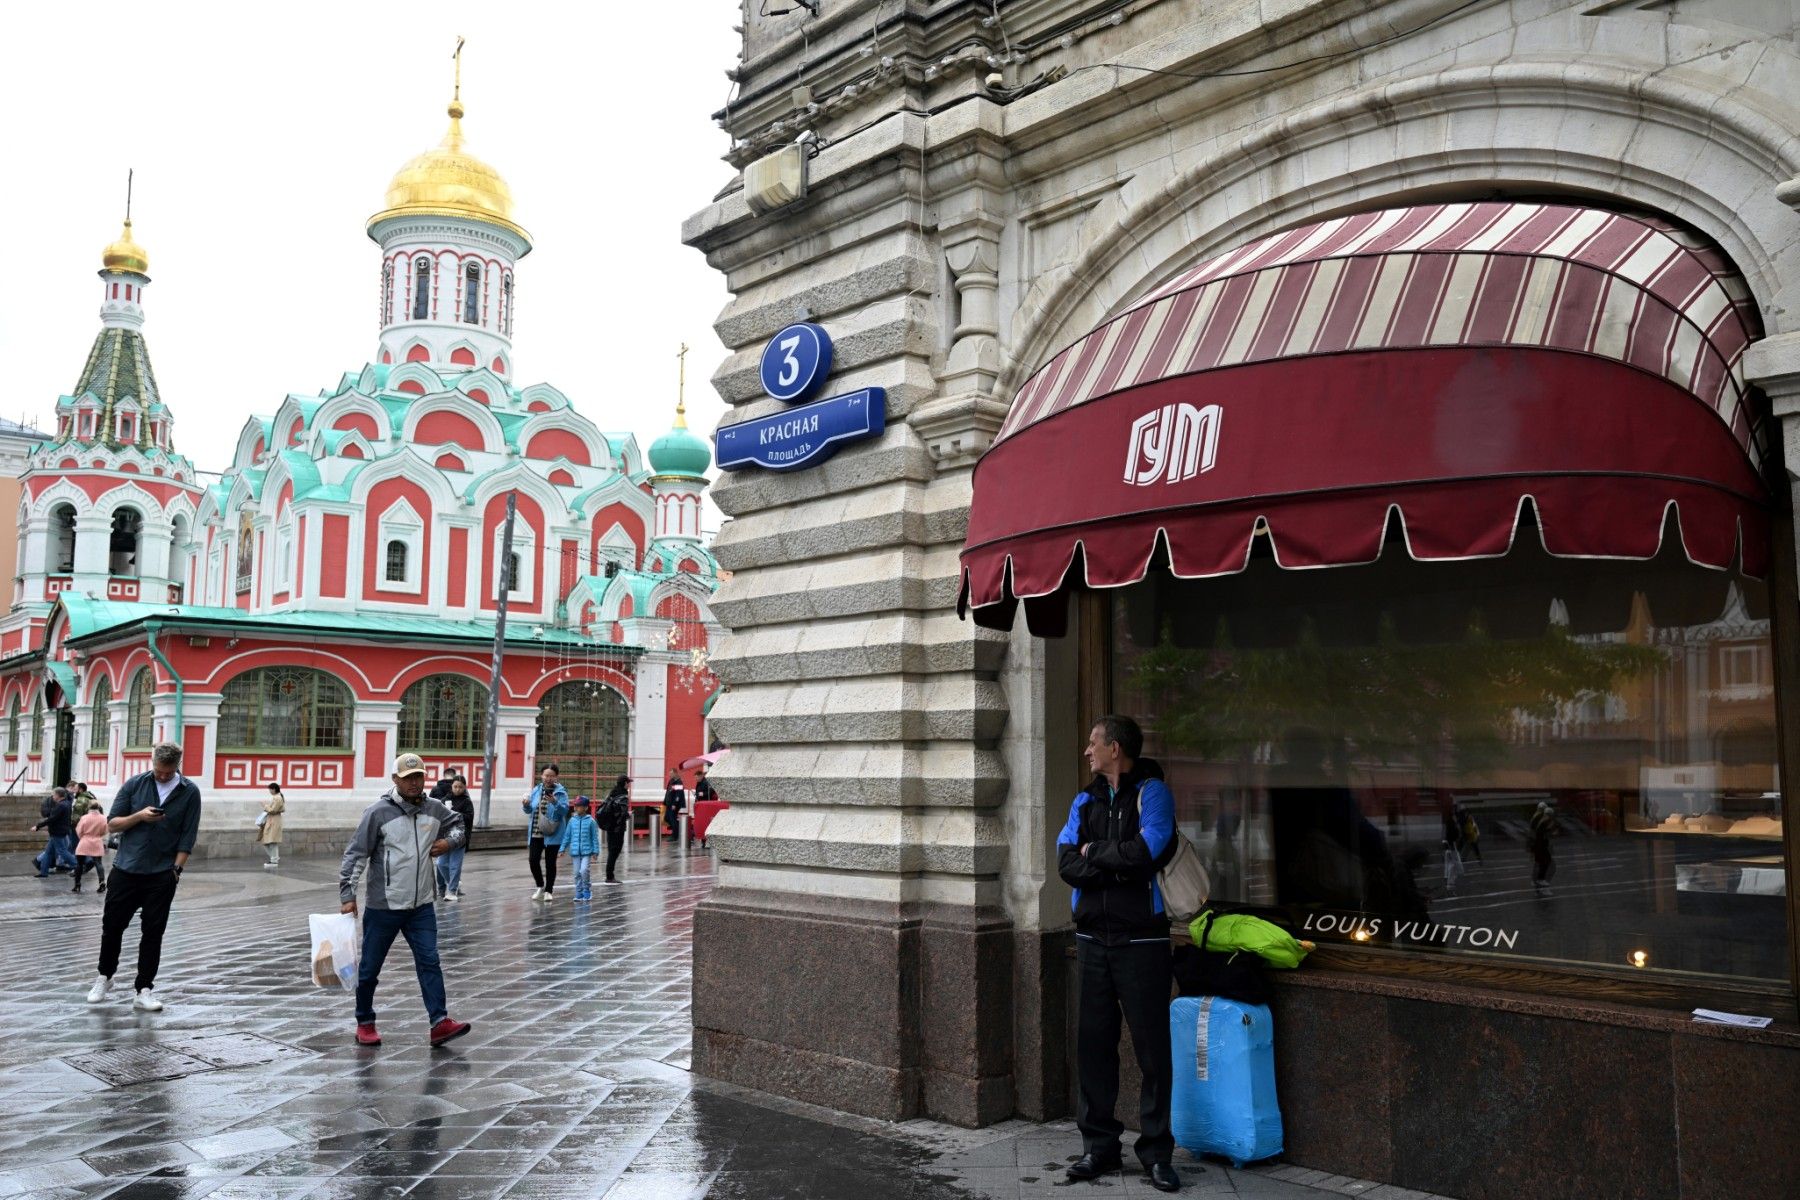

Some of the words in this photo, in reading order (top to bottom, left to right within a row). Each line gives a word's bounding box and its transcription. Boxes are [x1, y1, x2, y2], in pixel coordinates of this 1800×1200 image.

[778, 334, 801, 387] 3
[759, 414, 819, 445] КРАСНАЯ
[768, 442, 811, 461] ПЛОЩАДЬ
[1303, 913, 1383, 937] LOUIS
[1393, 920, 1519, 950] VUITTON
